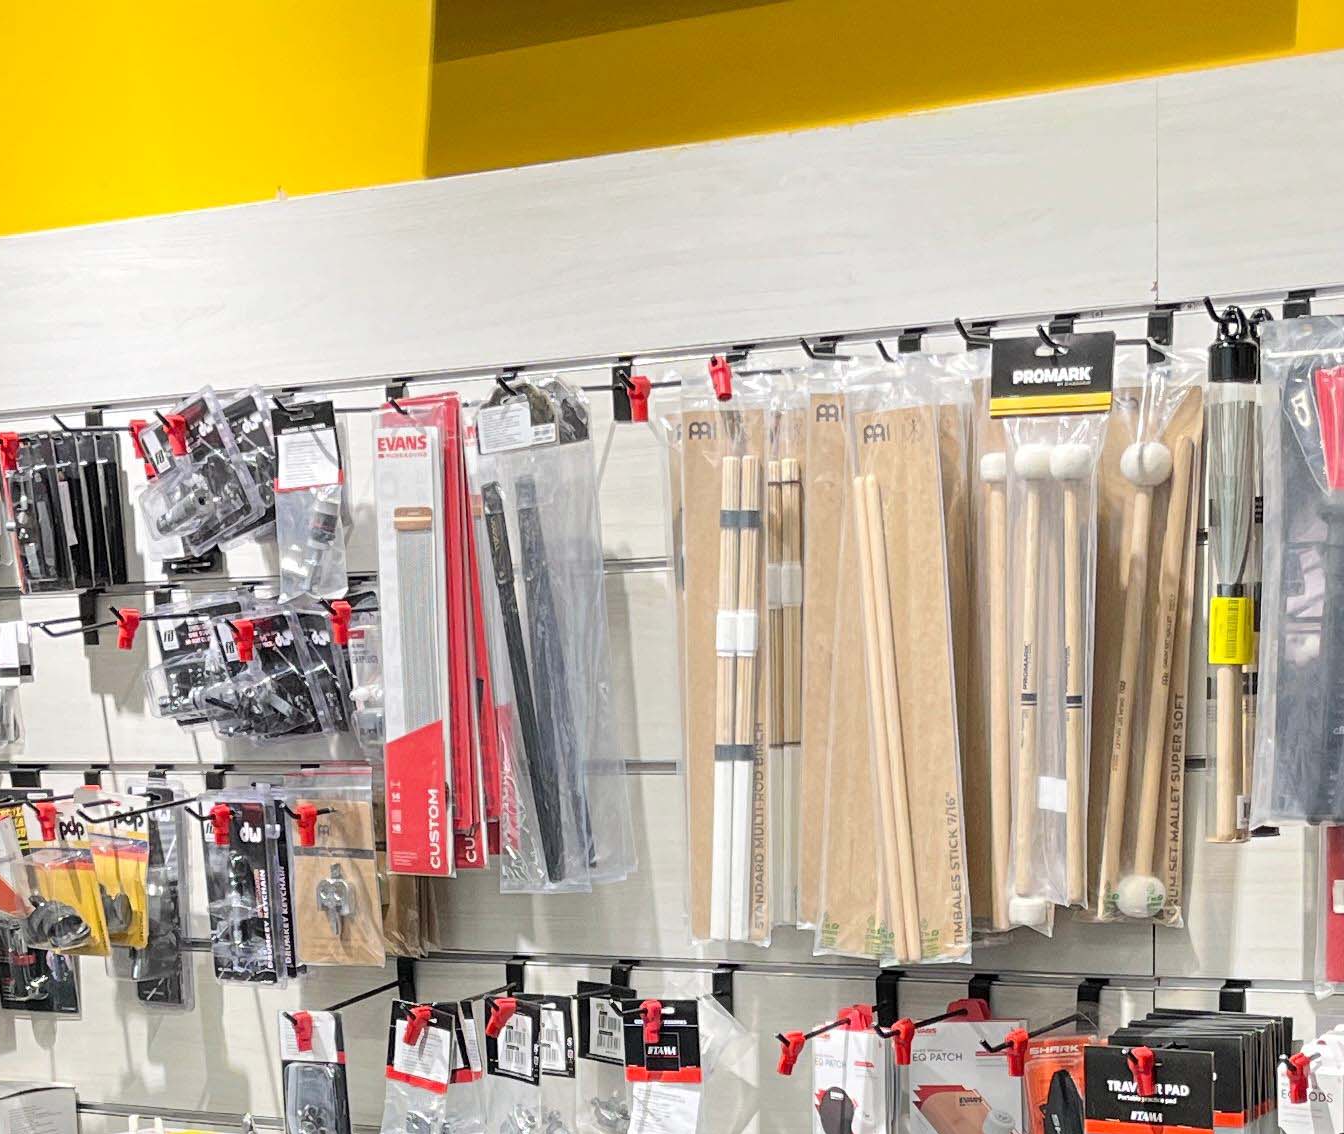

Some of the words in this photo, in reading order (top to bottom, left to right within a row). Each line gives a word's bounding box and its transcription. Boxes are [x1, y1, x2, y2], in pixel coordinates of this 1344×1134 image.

[1012, 366, 1092, 385] PROMARK
[377, 435, 426, 451] EVANS
[1173, 693, 1184, 727] SOFT
[1172, 732, 1182, 783] SUPER
[1170, 785, 1180, 841] MALLET
[60, 821, 84, 840] pdp
[429, 790, 441, 870] CUSTOM
[949, 830, 961, 872] STICK
[1168, 844, 1178, 871] SET
[754, 853, 764, 929] STANDARD
[949, 876, 965, 947] TIMBALES
[913, 1052, 927, 1062] EQ
[929, 1052, 962, 1062] PATCH
[1030, 1045, 1079, 1055] SHARK
[1106, 1079, 1163, 1096] TRAVR
[1165, 1084, 1189, 1096] PAD
